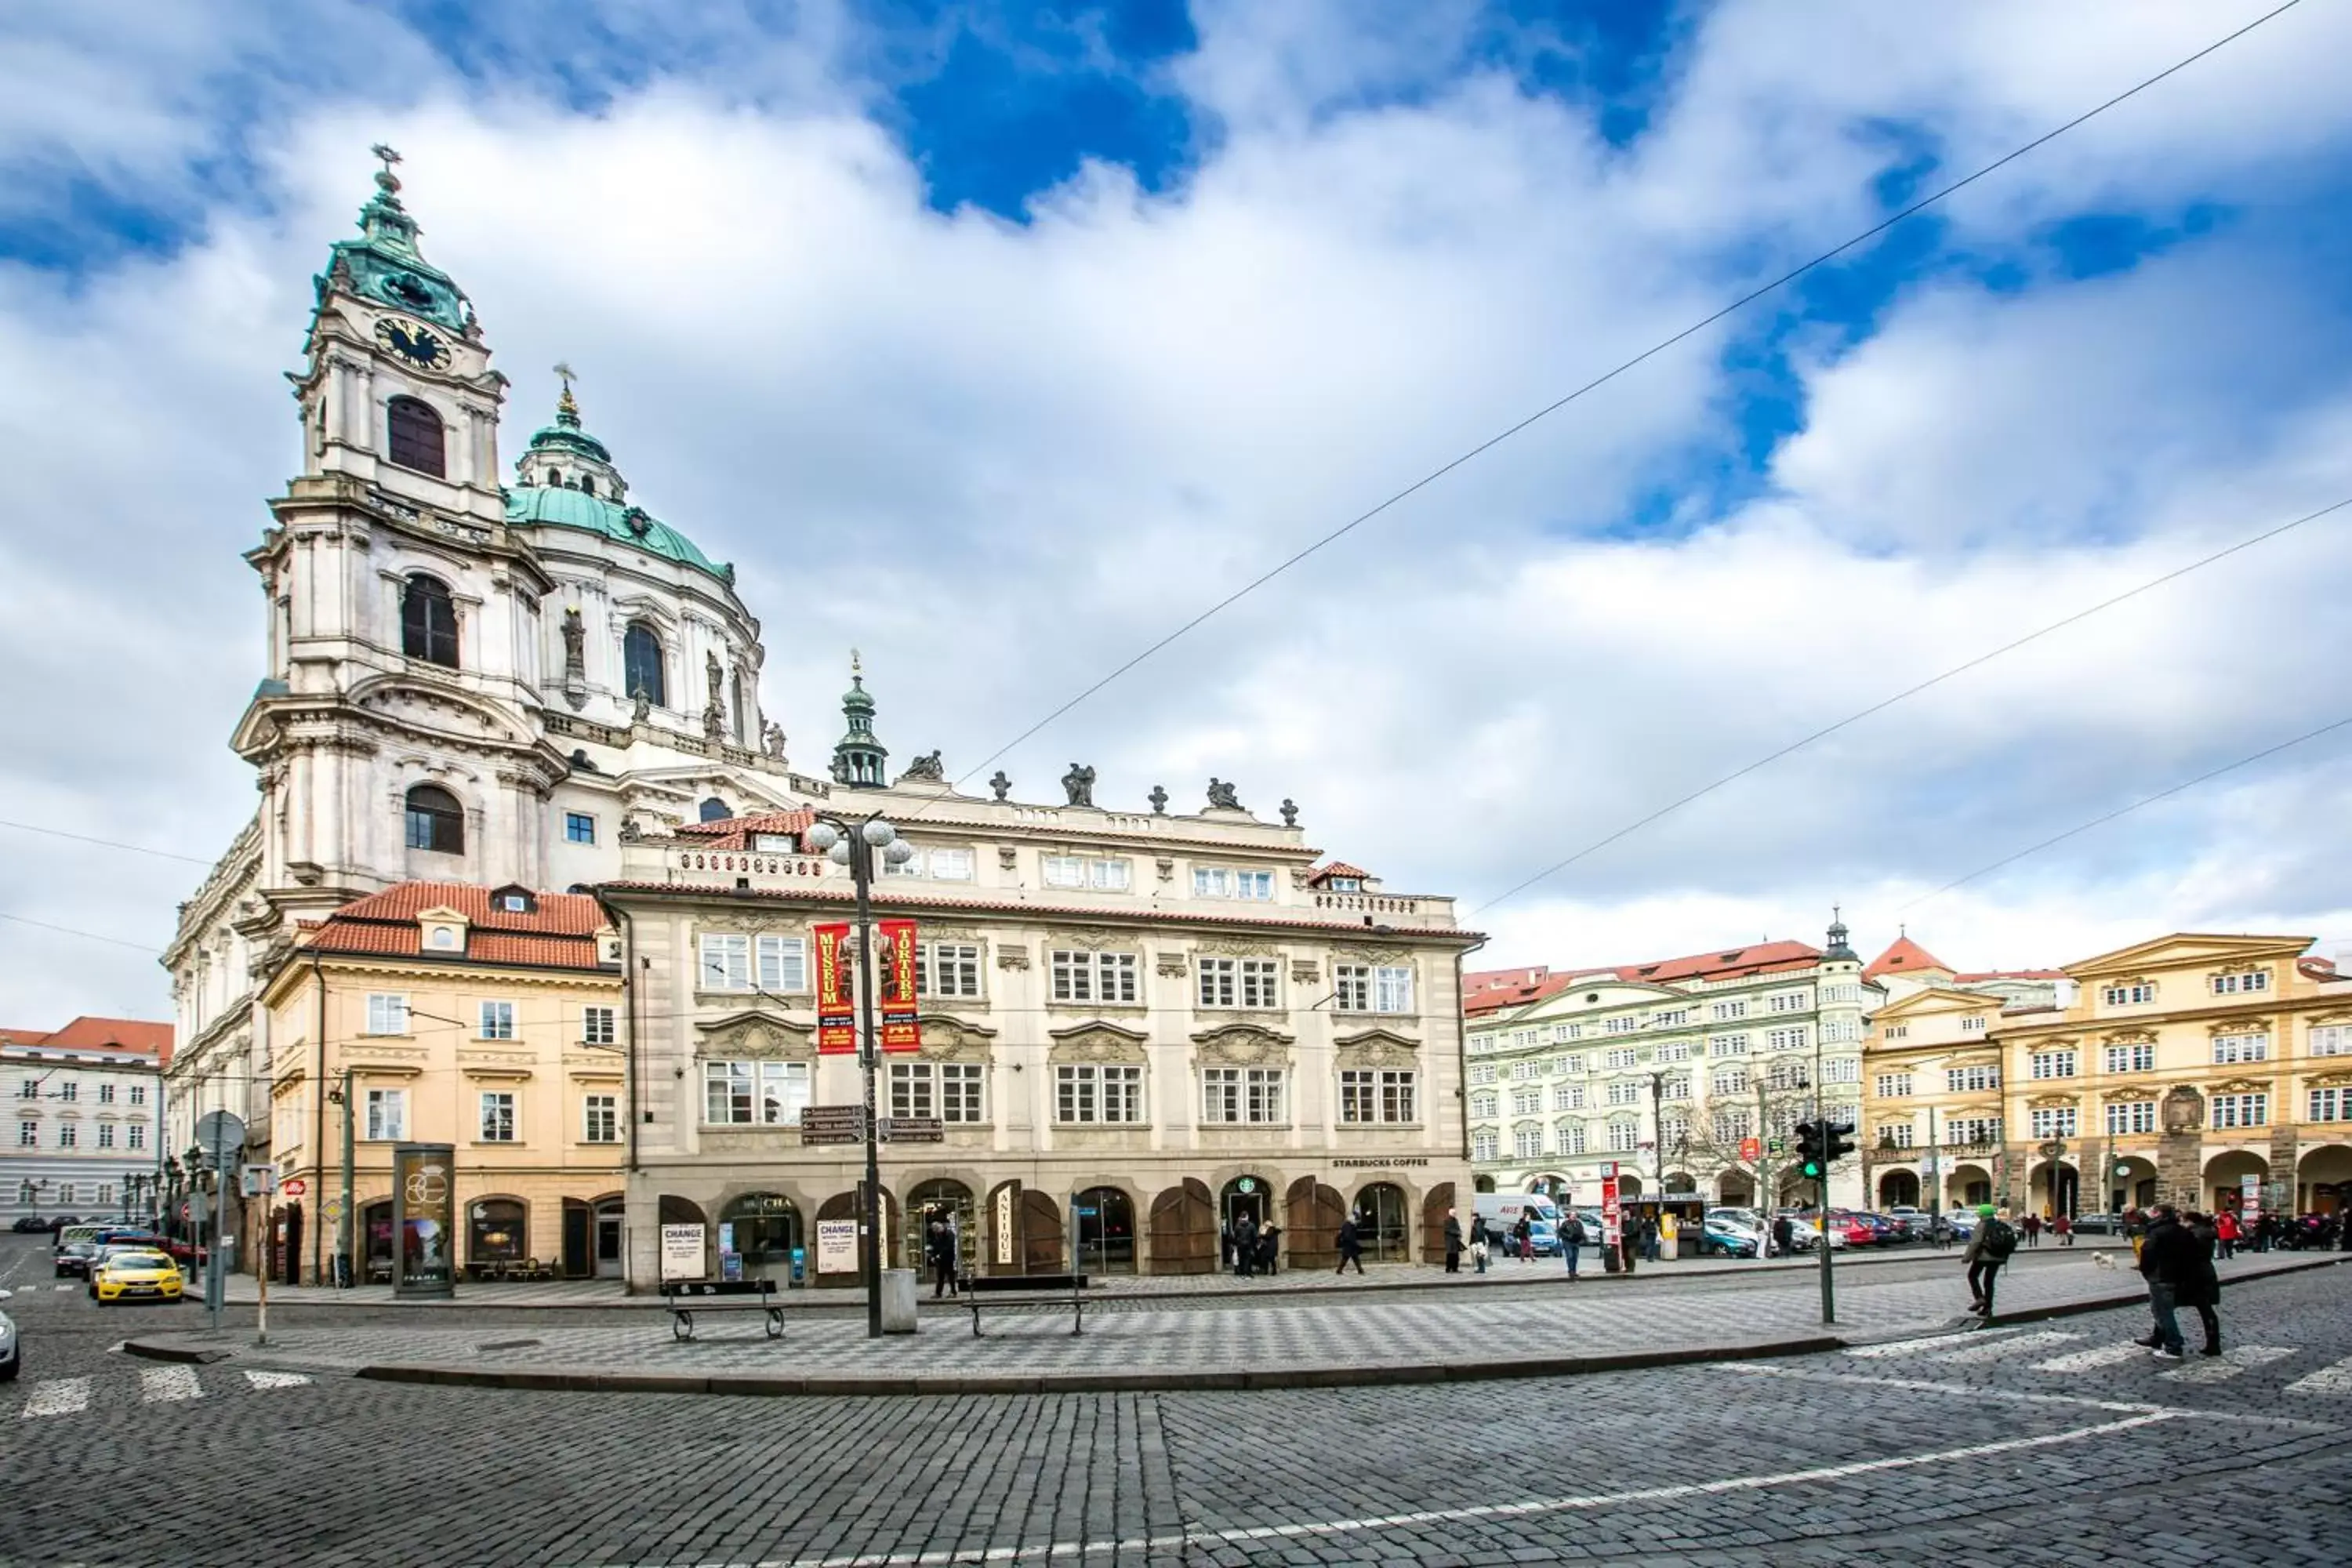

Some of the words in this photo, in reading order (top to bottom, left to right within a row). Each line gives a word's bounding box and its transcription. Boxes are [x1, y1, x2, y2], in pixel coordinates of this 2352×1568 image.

[819, 933, 837, 1004] MUSEUM
[898, 928, 913, 1001] TORTURE
[665, 1229, 702, 1238] CHANGE
[821, 1225, 855, 1234] CHANGE
[1000, 1194, 1009, 1259] ANTIQUE
